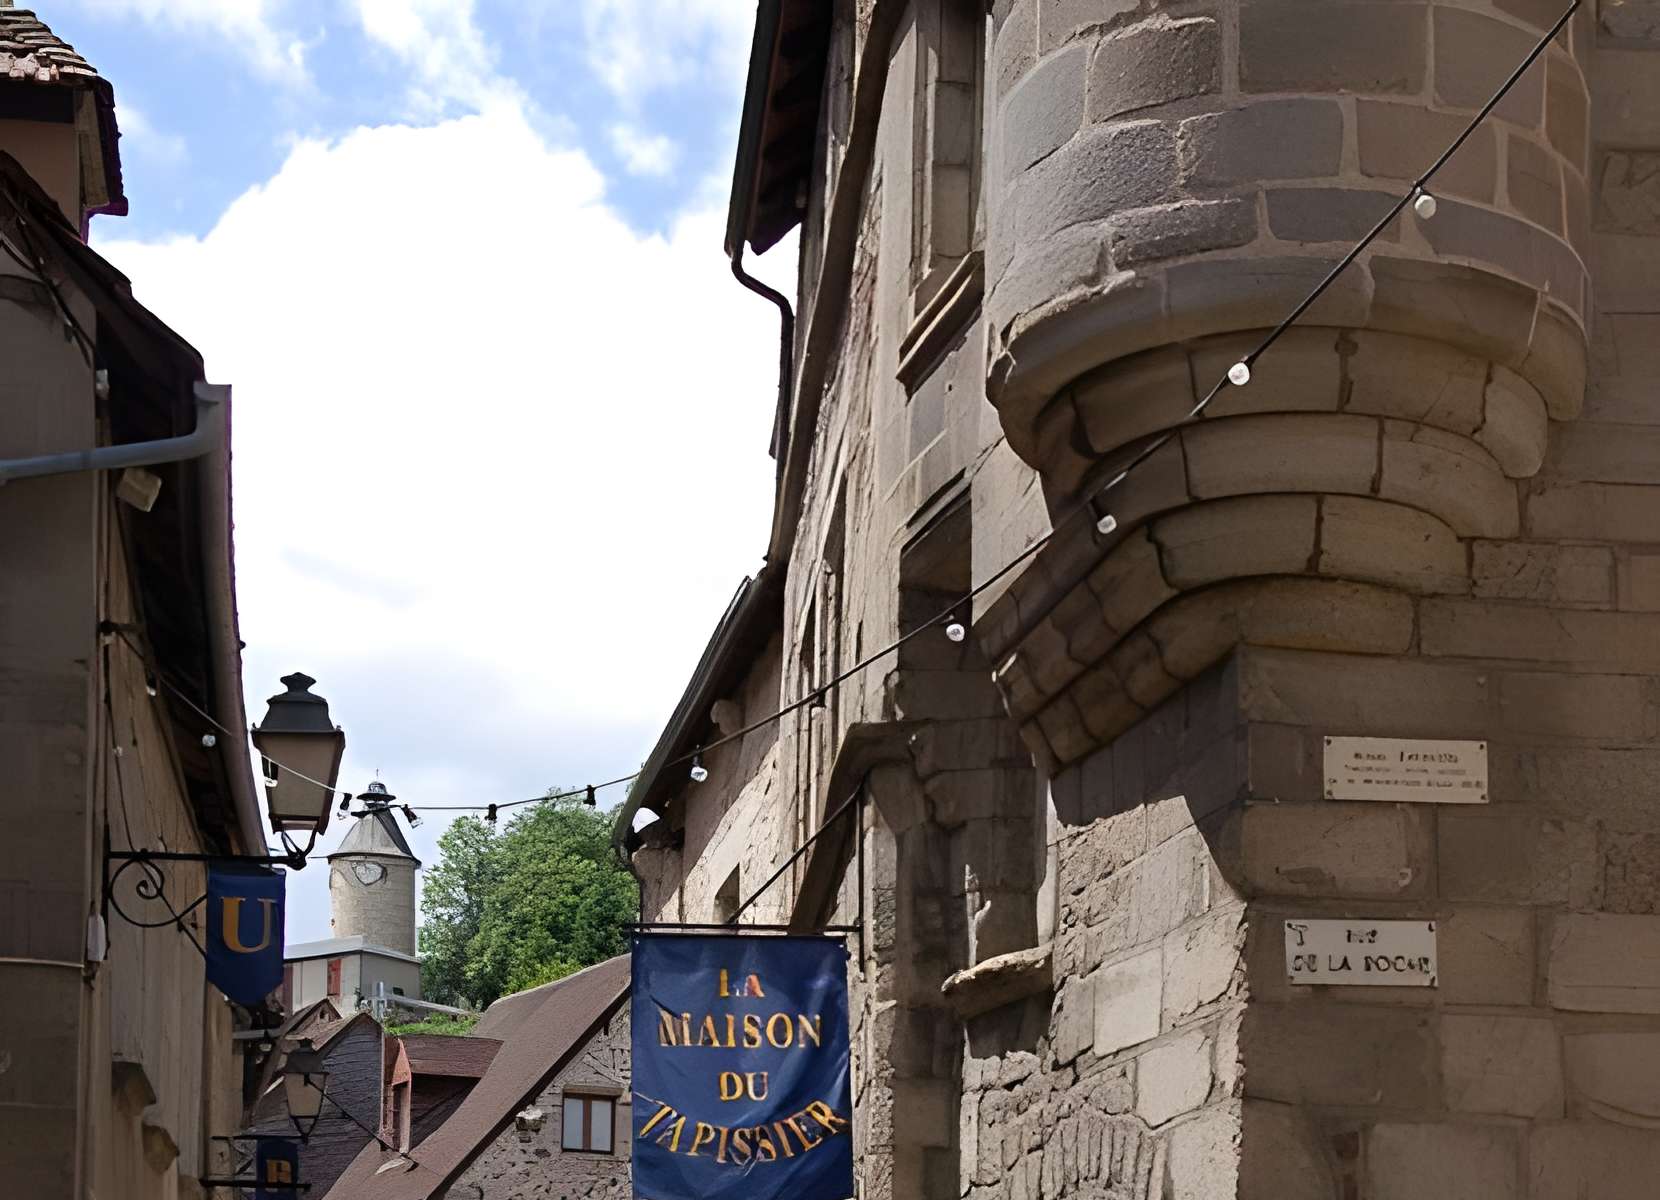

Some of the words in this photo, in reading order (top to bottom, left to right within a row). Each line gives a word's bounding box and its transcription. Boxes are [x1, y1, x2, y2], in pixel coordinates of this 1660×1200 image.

[221, 896, 278, 953] U
[1329, 955, 1352, 972] LA
[719, 968, 766, 998] LA
[657, 1010, 822, 1049] MAISON
[719, 1071, 769, 1101] DU
[636, 1099, 849, 1165] TAPISSIER
